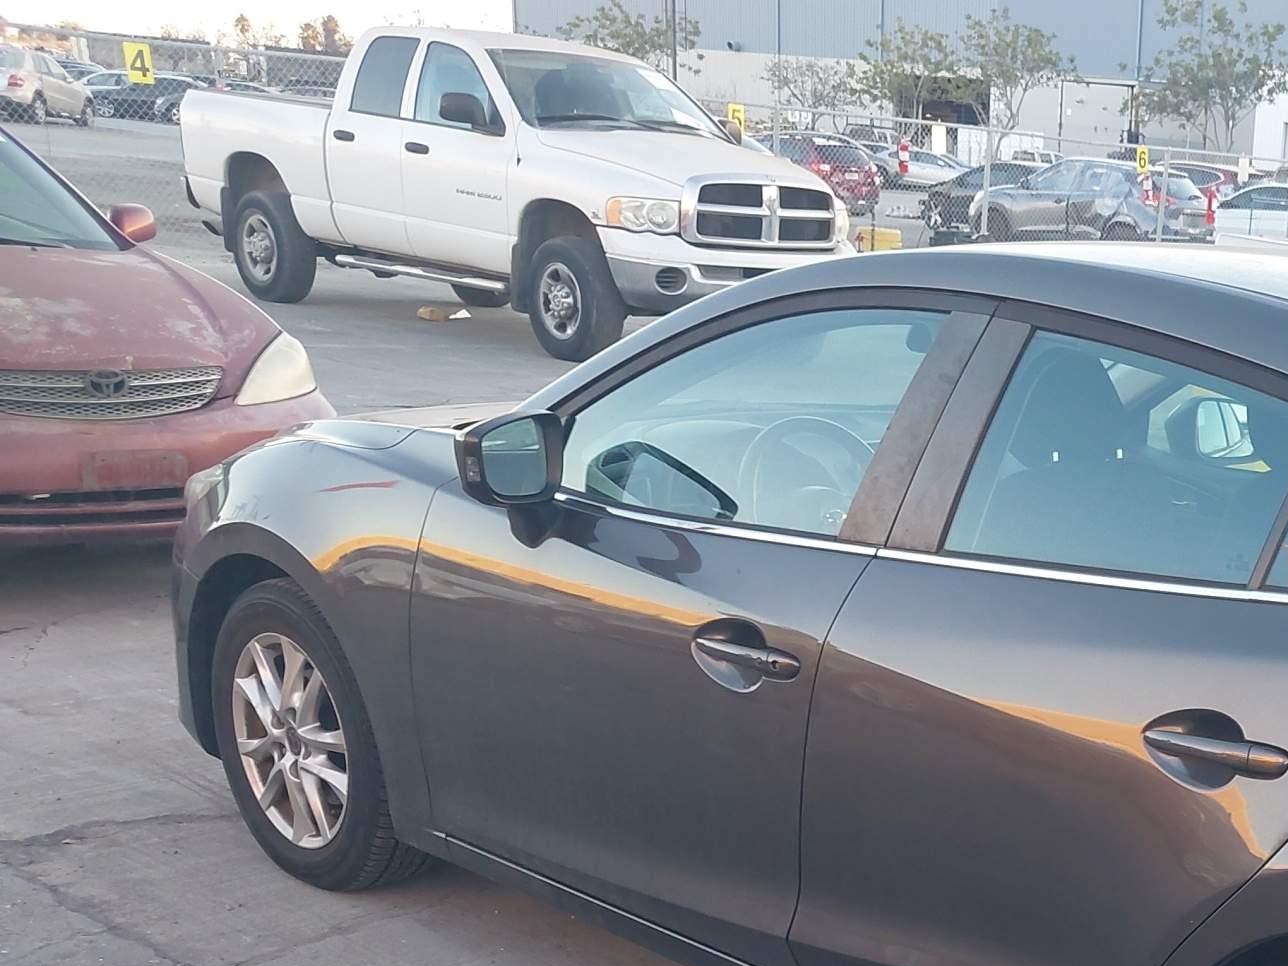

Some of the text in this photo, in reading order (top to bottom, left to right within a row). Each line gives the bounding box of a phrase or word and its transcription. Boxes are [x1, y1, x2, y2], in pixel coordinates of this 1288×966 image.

[130, 49, 150, 78] 4
[731, 108, 742, 129] 5
[1138, 150, 1147, 169] 6
